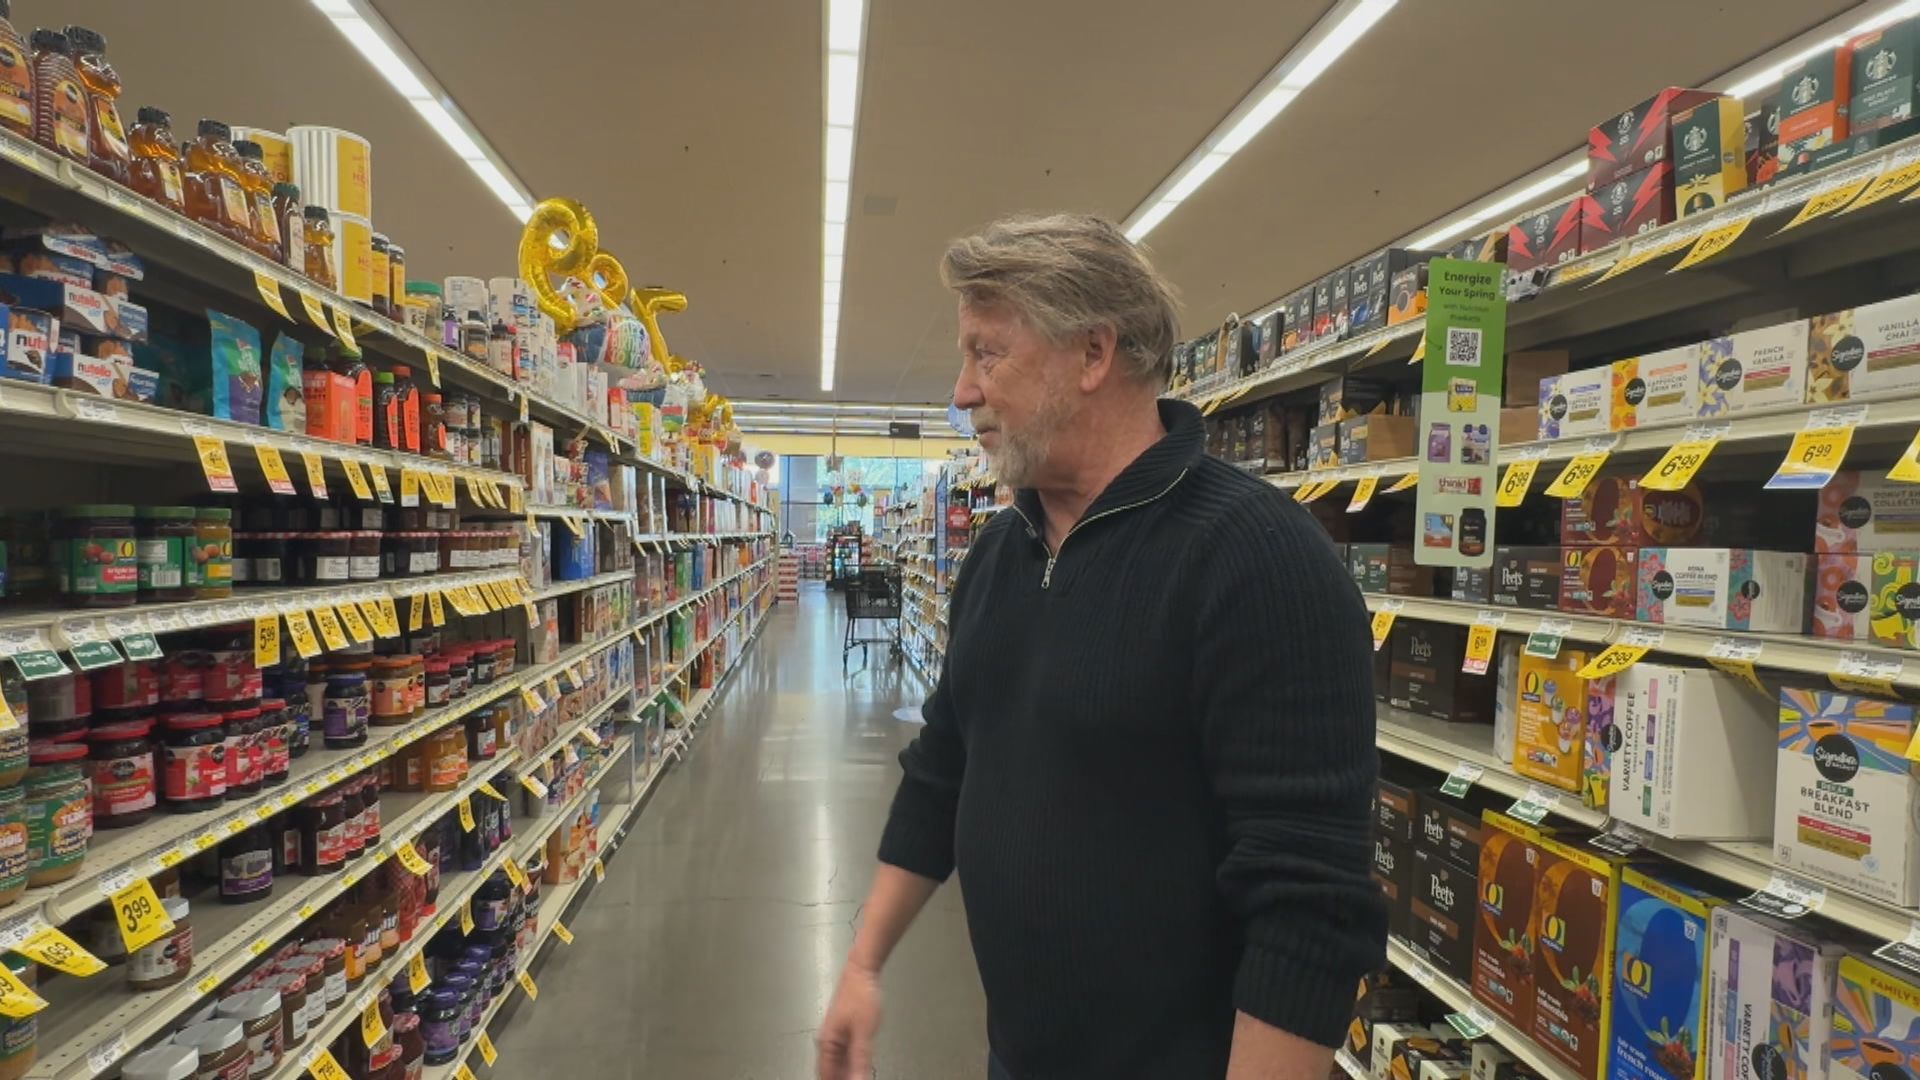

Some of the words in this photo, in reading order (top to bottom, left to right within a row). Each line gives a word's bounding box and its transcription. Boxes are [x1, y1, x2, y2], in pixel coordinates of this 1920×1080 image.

[1444, 271, 1492, 286] Energize
[1439, 286, 1461, 296] Your
[1463, 288, 1496, 301] Spring
[1884, 331, 1910, 341] CHAI
[1625, 692, 1635, 739] COFFEE
[1622, 741, 1632, 792] VARIETY
[1800, 786, 1870, 814] BREAKFAST
[1814, 801, 1853, 820] BLEND
[1870, 976, 1911, 1001] FAMILY
[1739, 1053, 1749, 1080] COF
